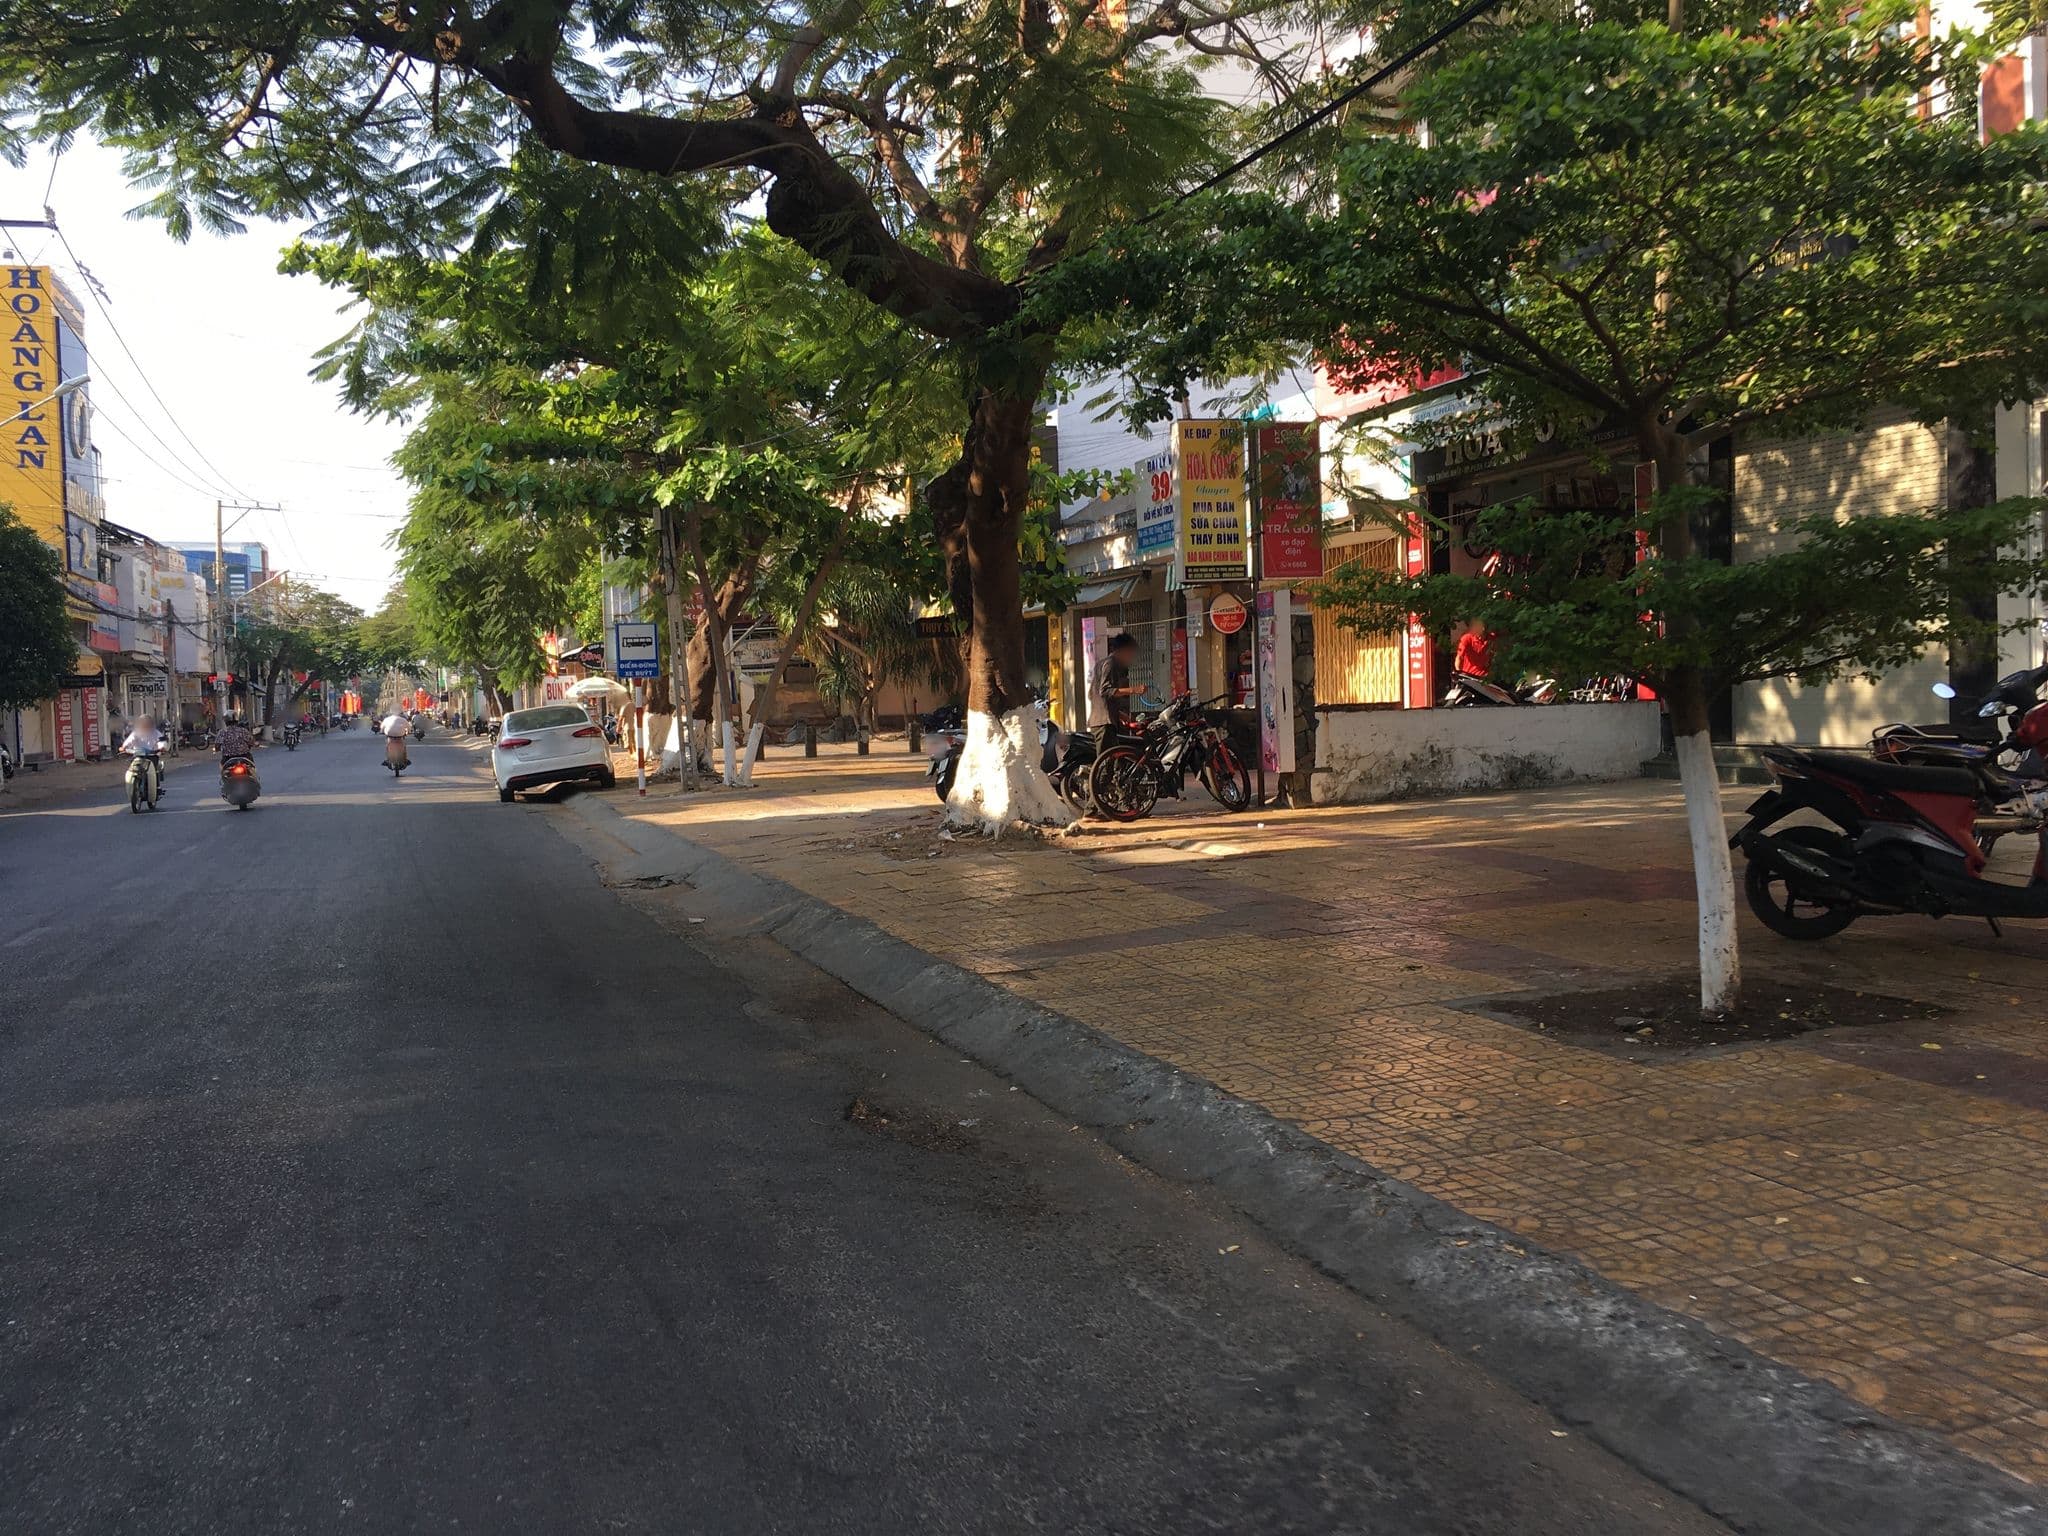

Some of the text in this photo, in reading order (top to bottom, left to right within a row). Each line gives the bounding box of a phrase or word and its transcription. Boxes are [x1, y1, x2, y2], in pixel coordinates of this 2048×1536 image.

[8, 268, 49, 469] HOÀNG LAN
[1184, 428, 1194, 440] XE
[1193, 501, 1212, 513] MUA
[1190, 531, 1240, 545] THAY BÌNH
